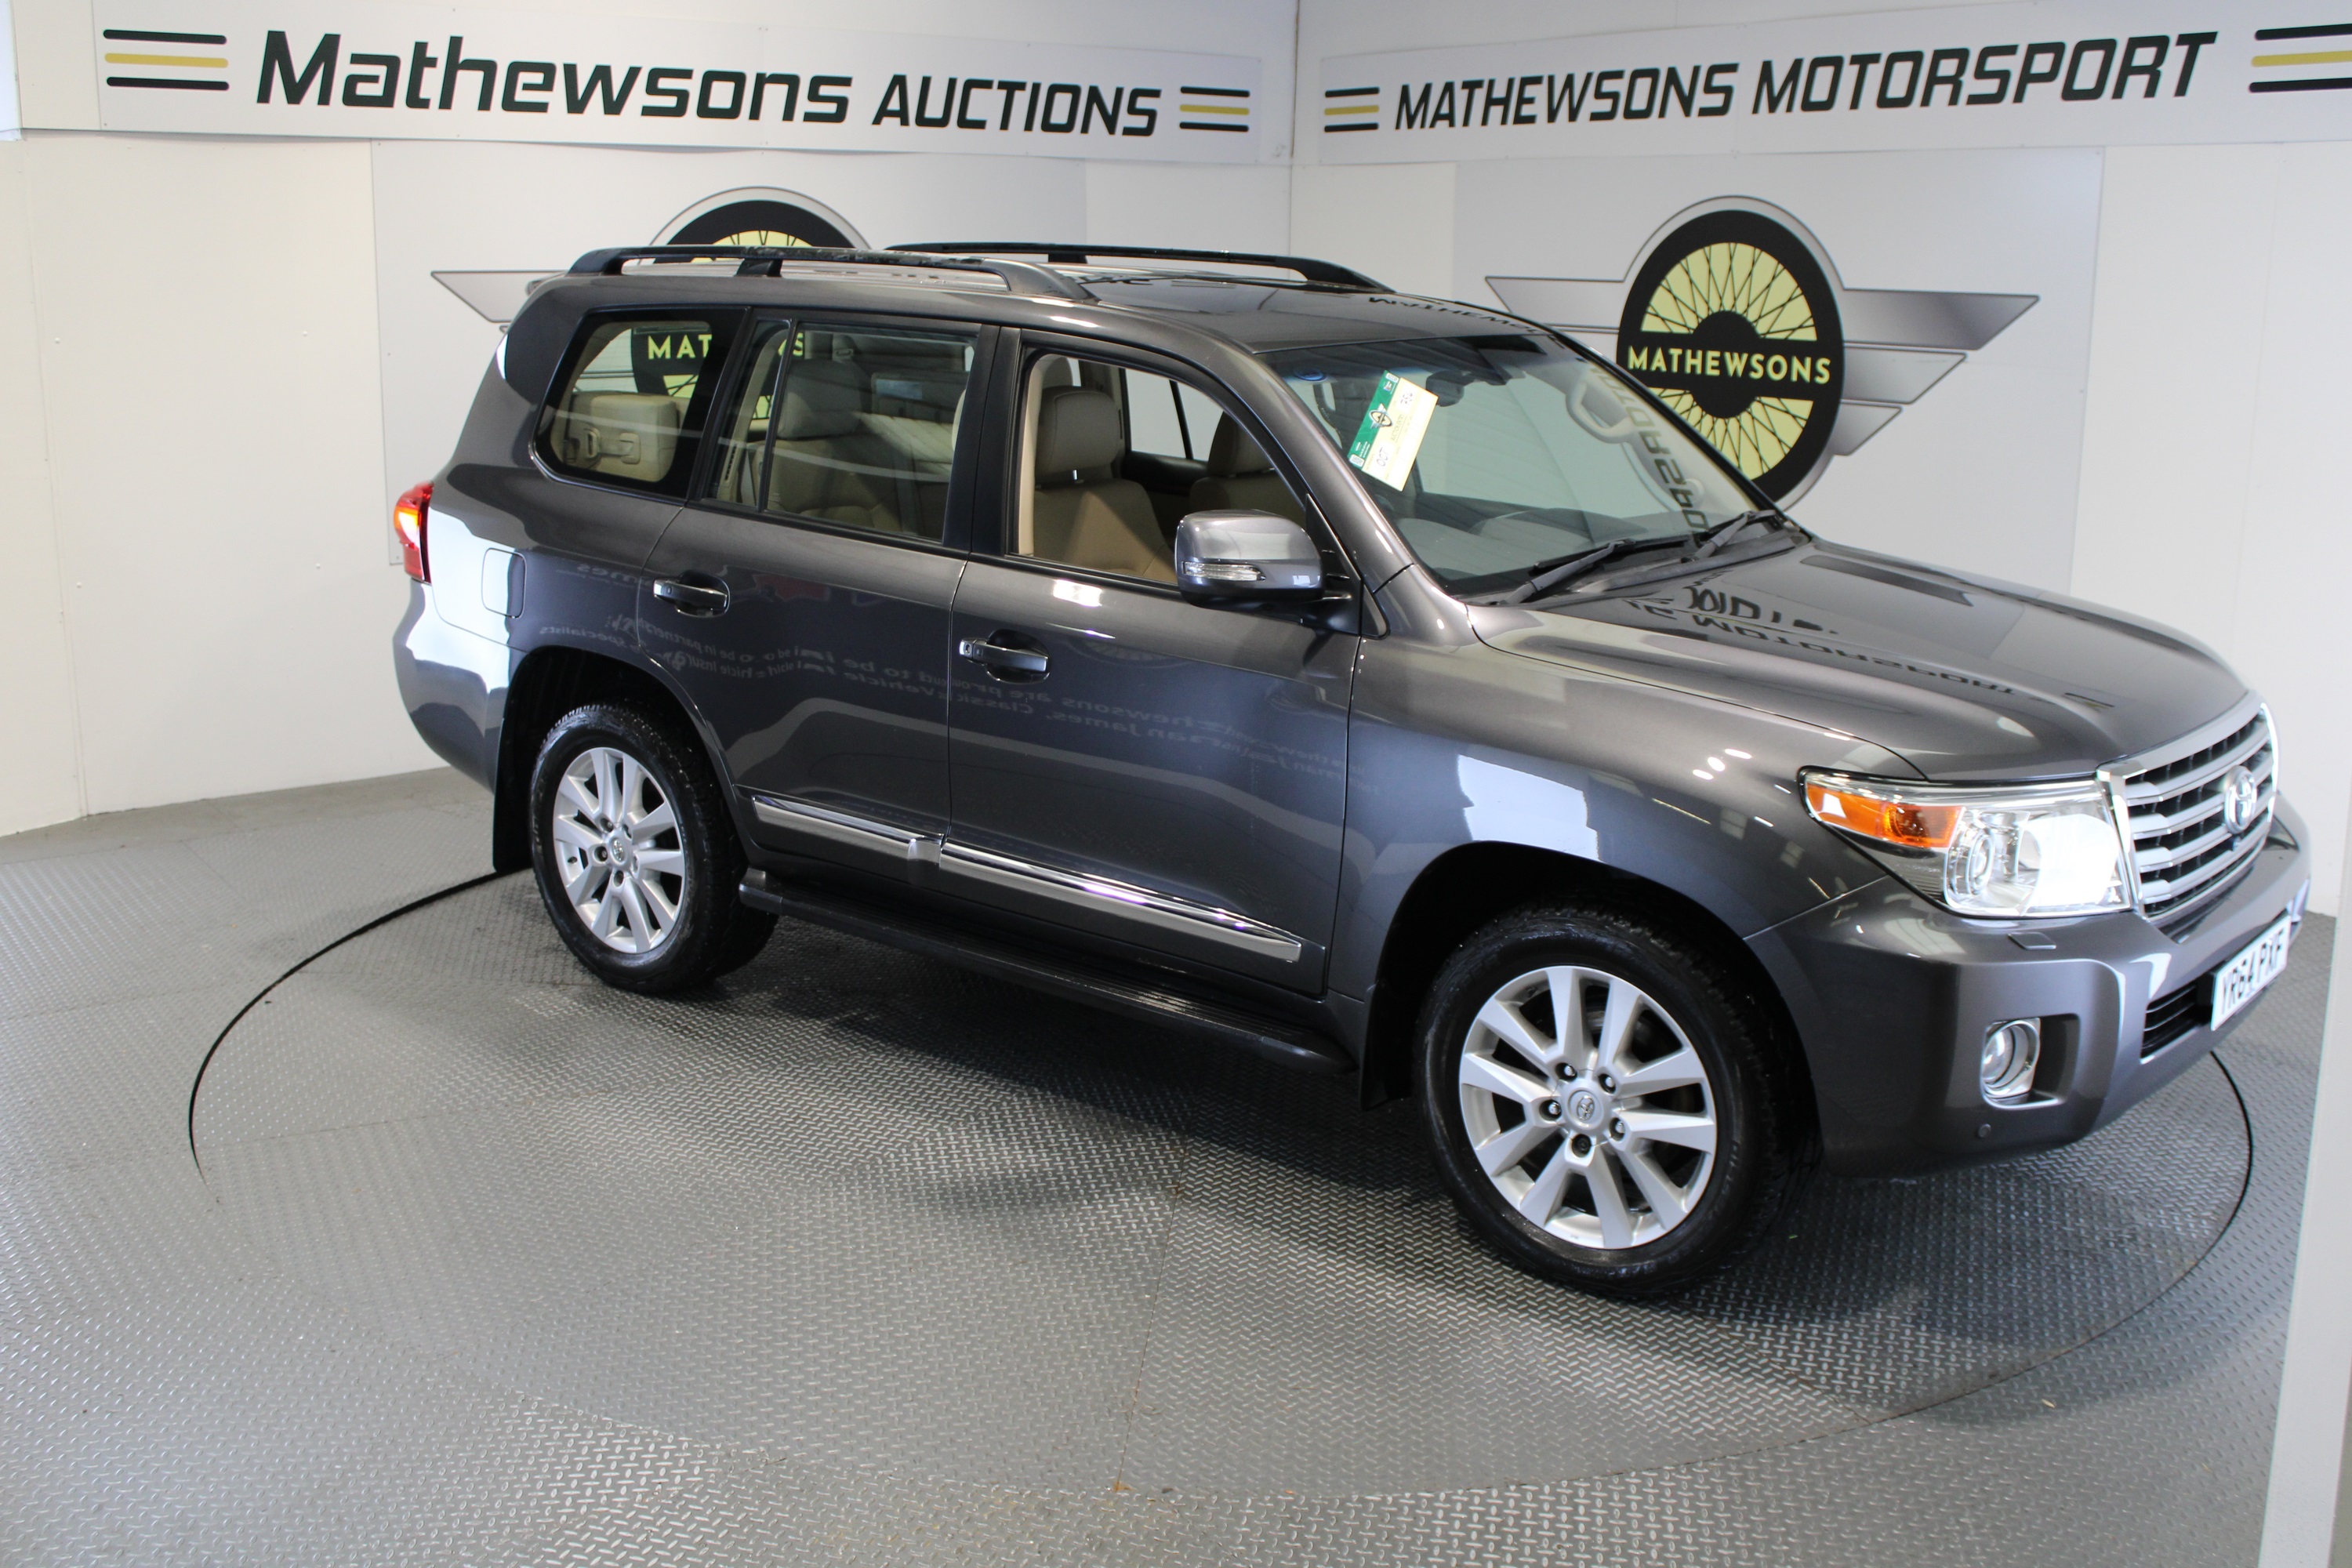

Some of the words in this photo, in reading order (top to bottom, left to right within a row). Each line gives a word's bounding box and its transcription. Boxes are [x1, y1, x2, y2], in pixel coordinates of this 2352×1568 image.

[257, 31, 853, 123] Mathewsons
[872, 74, 1162, 137] AUCTIONS
[1396, 63, 1739, 130] MATHEWSONS
[1751, 31, 2219, 114] MOTORSPORT
[1627, 345, 1831, 385] MATHEWSONS
[1376, 447, 1390, 467] OCT
